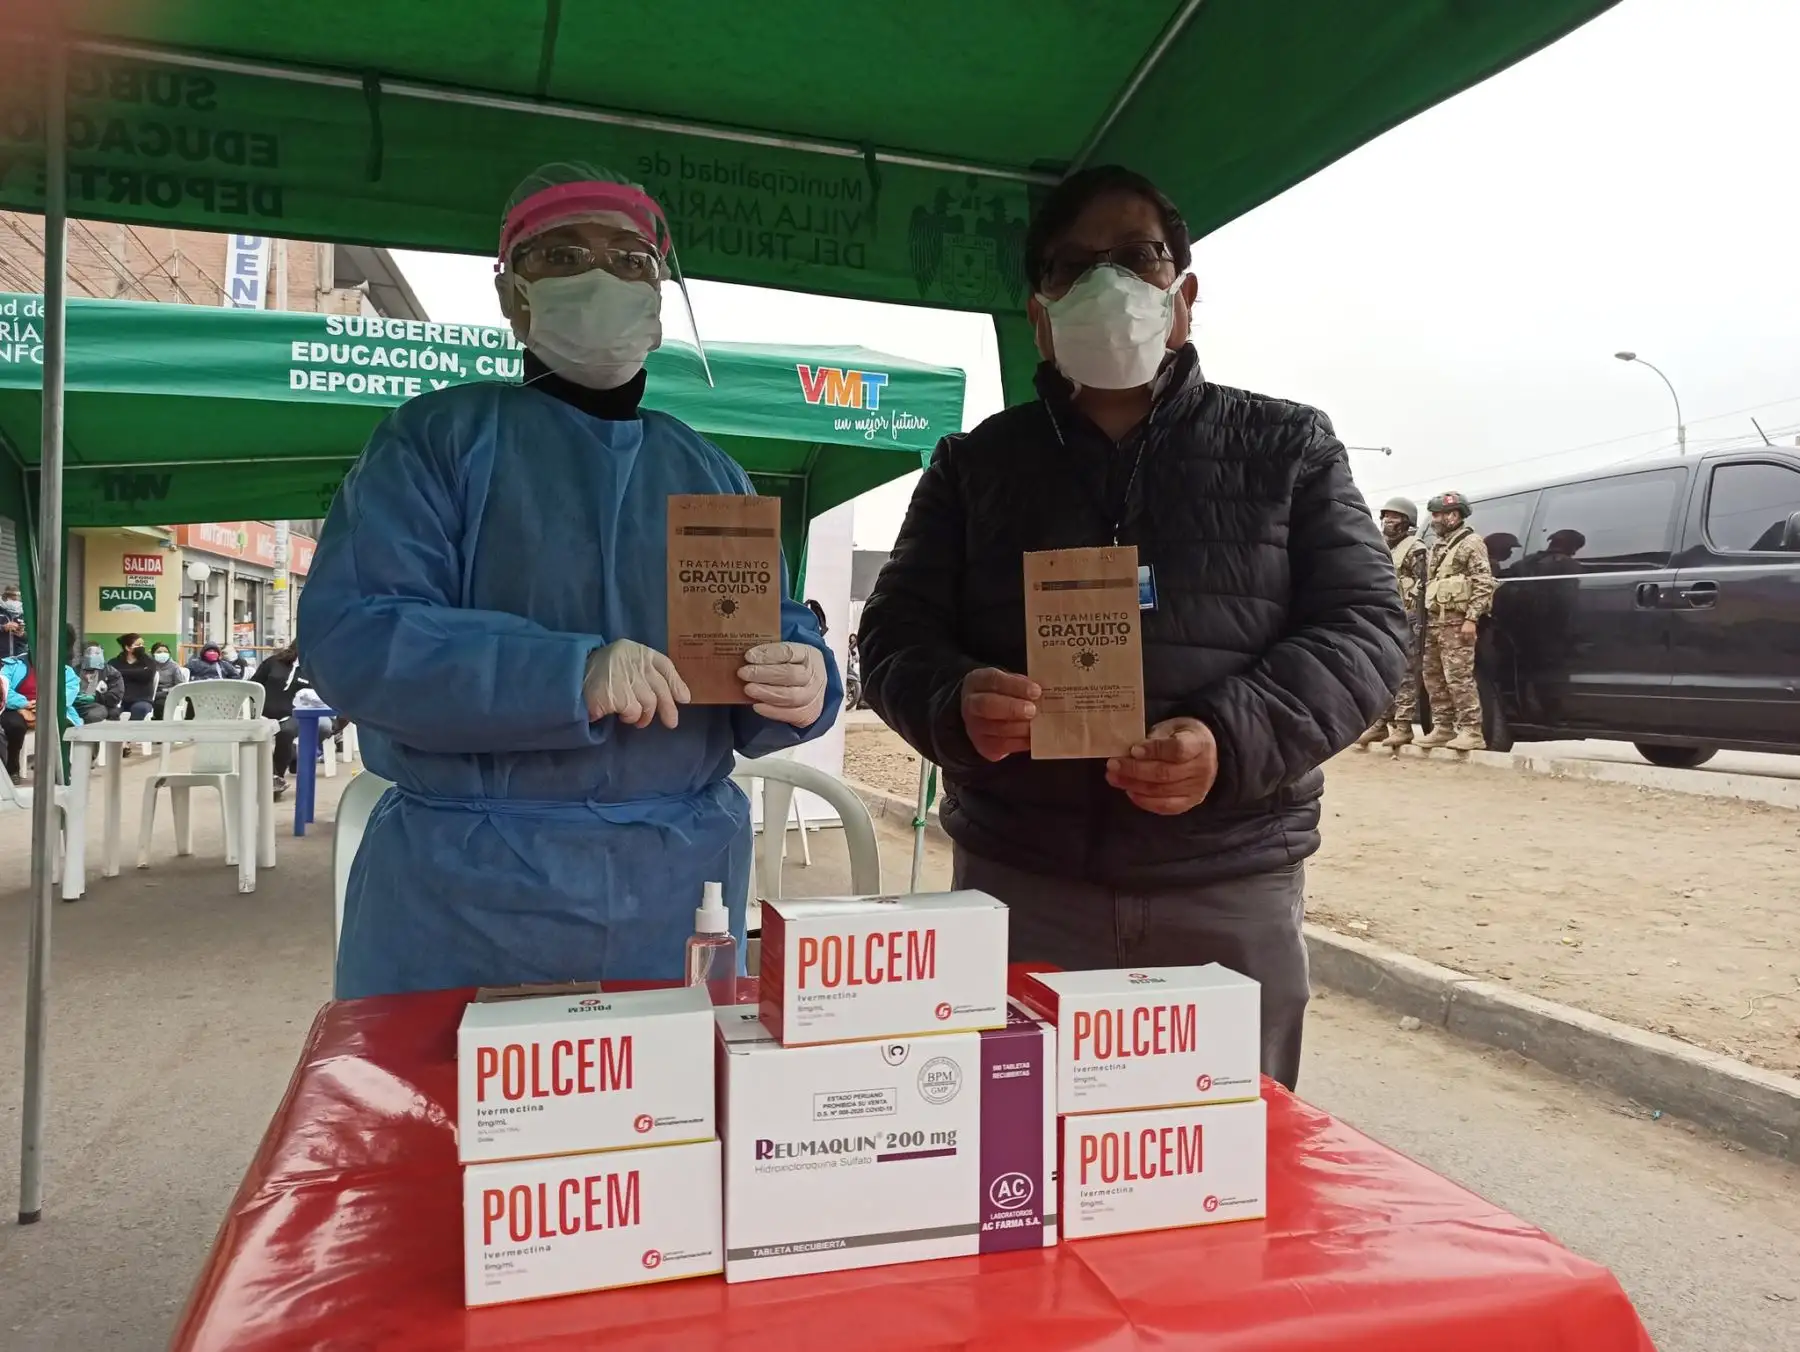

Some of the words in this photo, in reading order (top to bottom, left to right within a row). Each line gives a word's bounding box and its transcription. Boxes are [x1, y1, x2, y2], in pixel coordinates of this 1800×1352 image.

[291, 341, 467, 378] EDUCACIÓN,
[289, 369, 422, 397] DEPORTE
[796, 364, 889, 411] VMT
[834, 417, 851, 431] un
[855, 411, 889, 440] mejor
[124, 557, 162, 573] SALIDA
[679, 559, 770, 569] TRATAMIENTO
[678, 569, 771, 584] GRATUITO
[101, 589, 154, 601] SALIDA
[682, 584, 708, 594] para
[708, 584, 768, 594] COVID-19
[1037, 611, 1129, 623] TRATAMIENTO
[1037, 622, 1131, 638] GRATUITO
[1042, 639, 1066, 649] para
[1066, 635, 1127, 647] COVID-19
[798, 929, 936, 989] POLCEM
[797, 992, 857, 1001] Ivermectina
[1073, 1004, 1196, 1061] POLCEM
[476, 1036, 633, 1102] POLCEM
[1073, 1064, 1127, 1073] Ivermectina
[927, 1071, 953, 1083] BPM
[477, 1105, 545, 1116] Ivermectina
[886, 1130, 926, 1149] 200
[930, 1129, 957, 1147] mg
[839, 1155, 873, 1167] Sulfato
[1080, 1125, 1204, 1186] POLCEM
[998, 1178, 1026, 1199] AC
[1080, 1187, 1134, 1198] Ivermectina
[483, 1170, 640, 1246] POLCEM
[982, 1222, 994, 1231] AC
[995, 1219, 1024, 1230] FARMA
[484, 1245, 552, 1260] Ivermectina
[752, 1246, 792, 1257] TABLETA
[792, 1240, 846, 1253] RECUBIERTA
